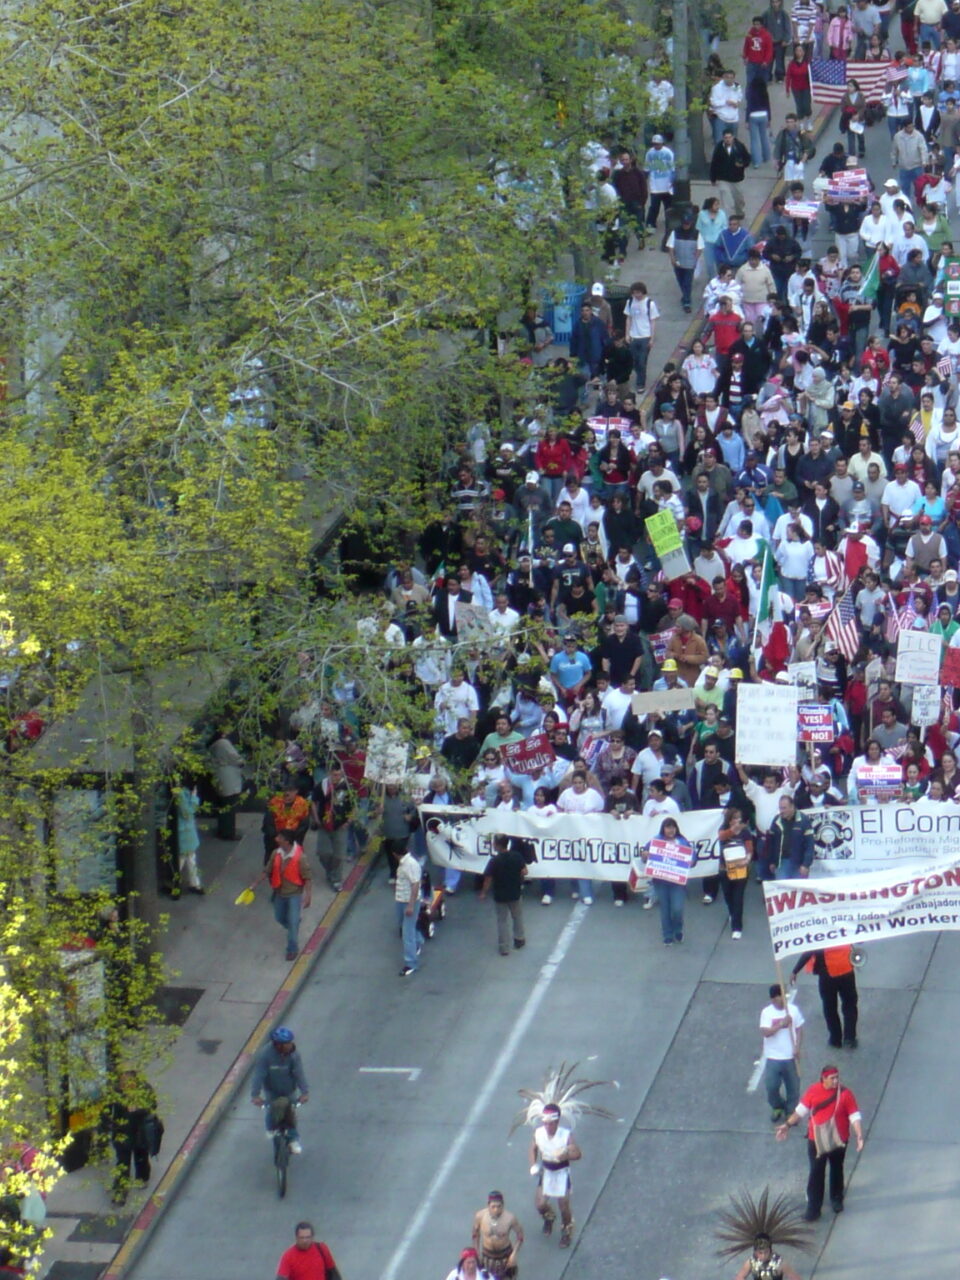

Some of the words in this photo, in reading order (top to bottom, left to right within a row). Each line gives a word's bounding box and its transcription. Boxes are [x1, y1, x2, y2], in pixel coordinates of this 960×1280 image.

[803, 714, 823, 724] YES!
[811, 730, 829, 740] NO!
[860, 809, 884, 834] El
[861, 836, 936, 846] Pro-Reforma
[541, 836, 632, 866] CENTRO
[894, 845, 939, 856] Justicia
[831, 913, 854, 927] para
[774, 927, 848, 953] Protect
[855, 921, 882, 935] All
